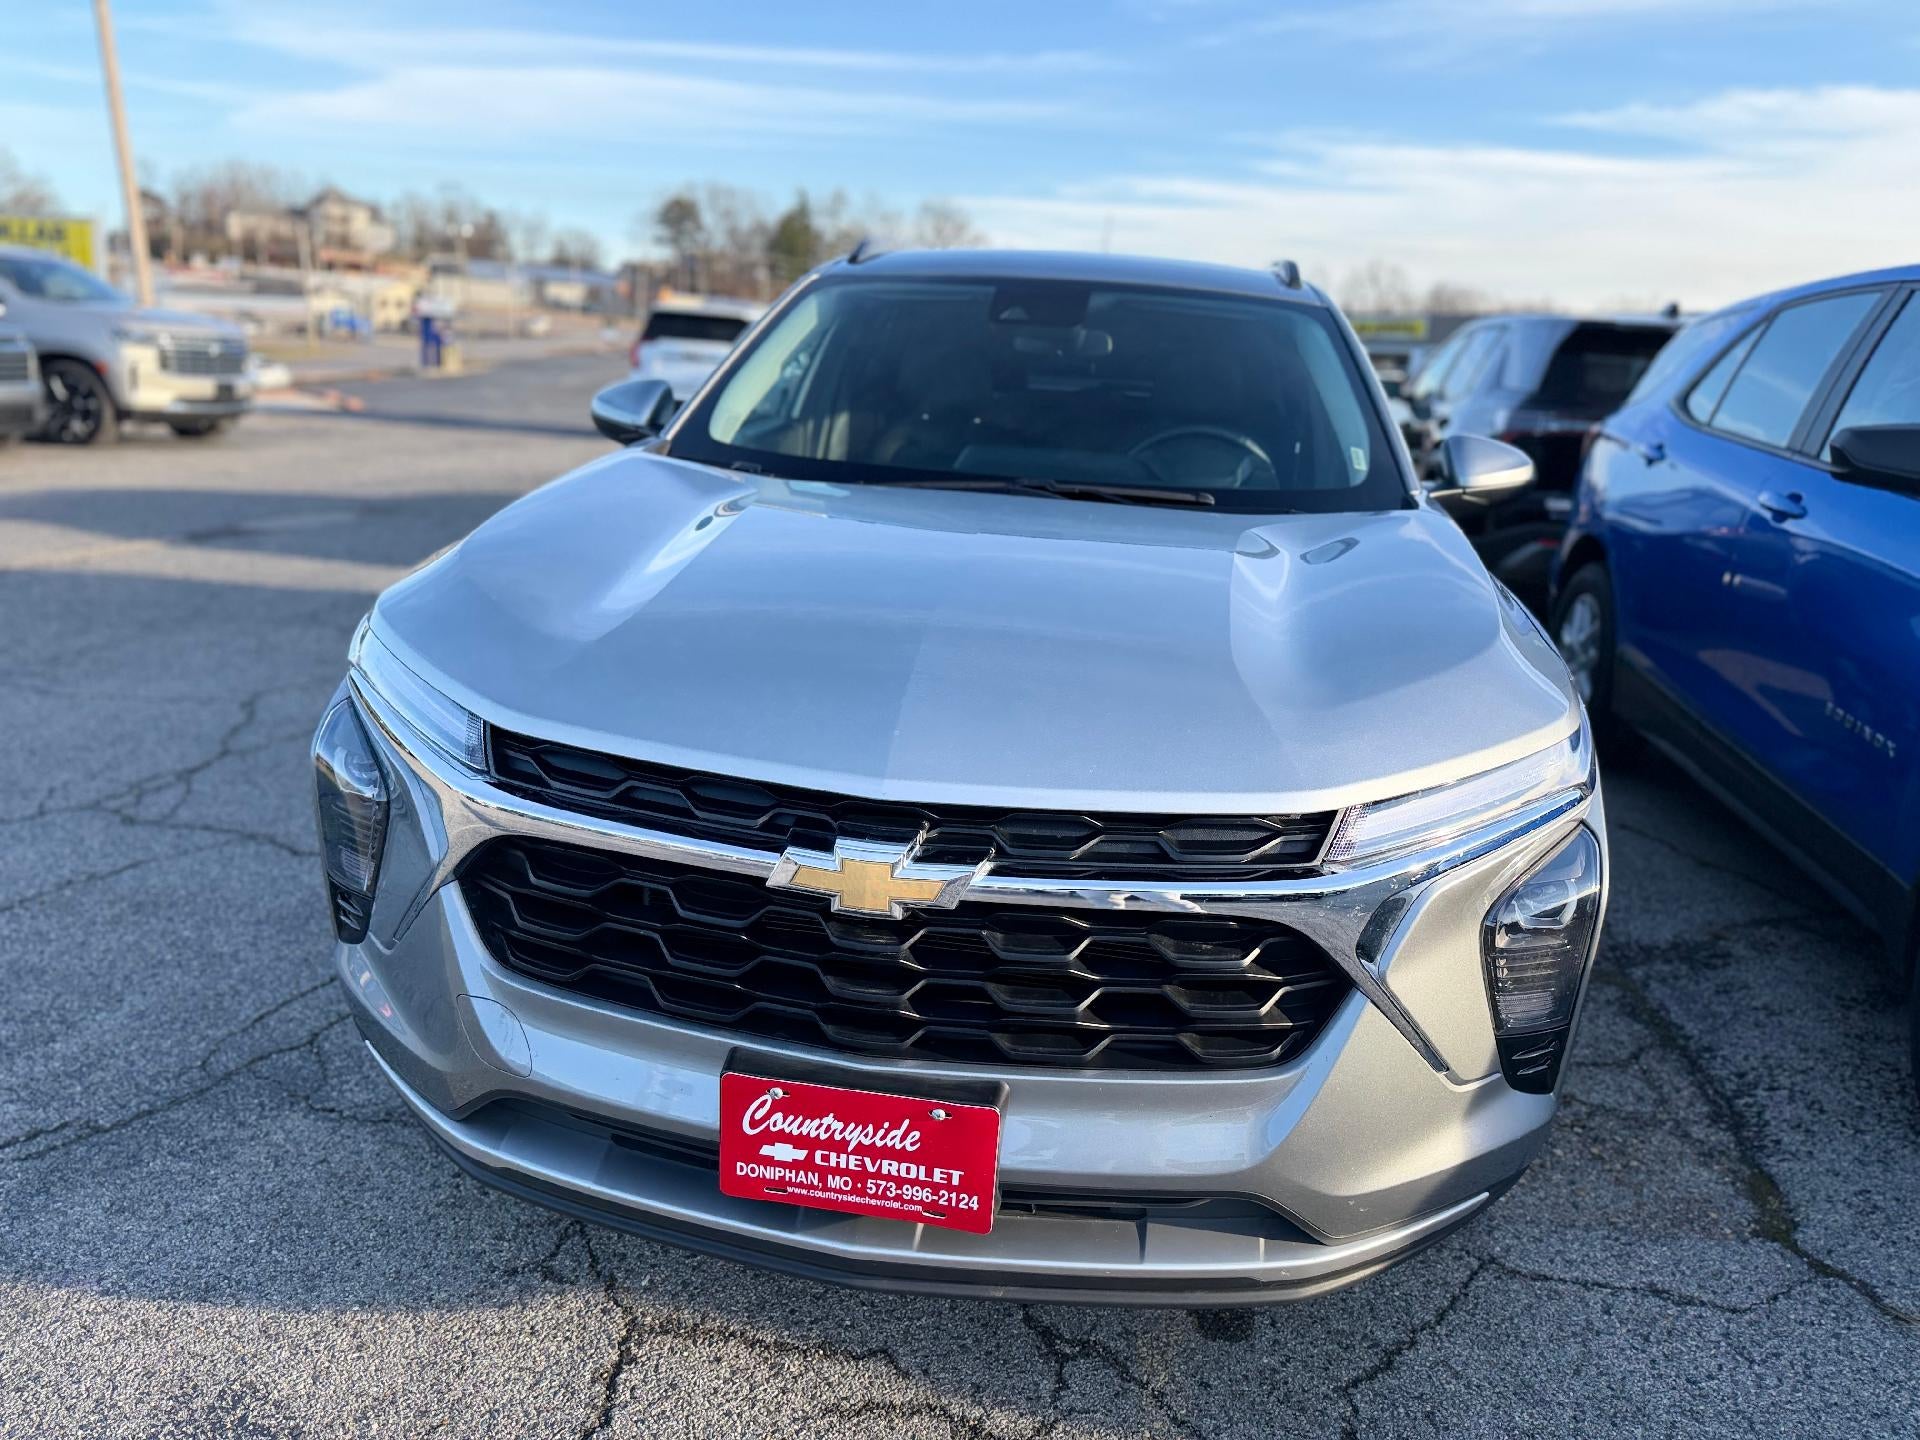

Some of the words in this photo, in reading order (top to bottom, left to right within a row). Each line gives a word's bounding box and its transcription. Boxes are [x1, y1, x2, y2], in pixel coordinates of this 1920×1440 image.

[742, 1094, 921, 1152] Countryside
[736, 1161, 823, 1190] DONIPHAN,
[827, 1176, 853, 1191] MO
[866, 1179, 979, 1211] 573-996-2124
[814, 1149, 965, 1186] CHEVROLET
[786, 1185, 923, 1212] www.countrysidechevrolet.com
